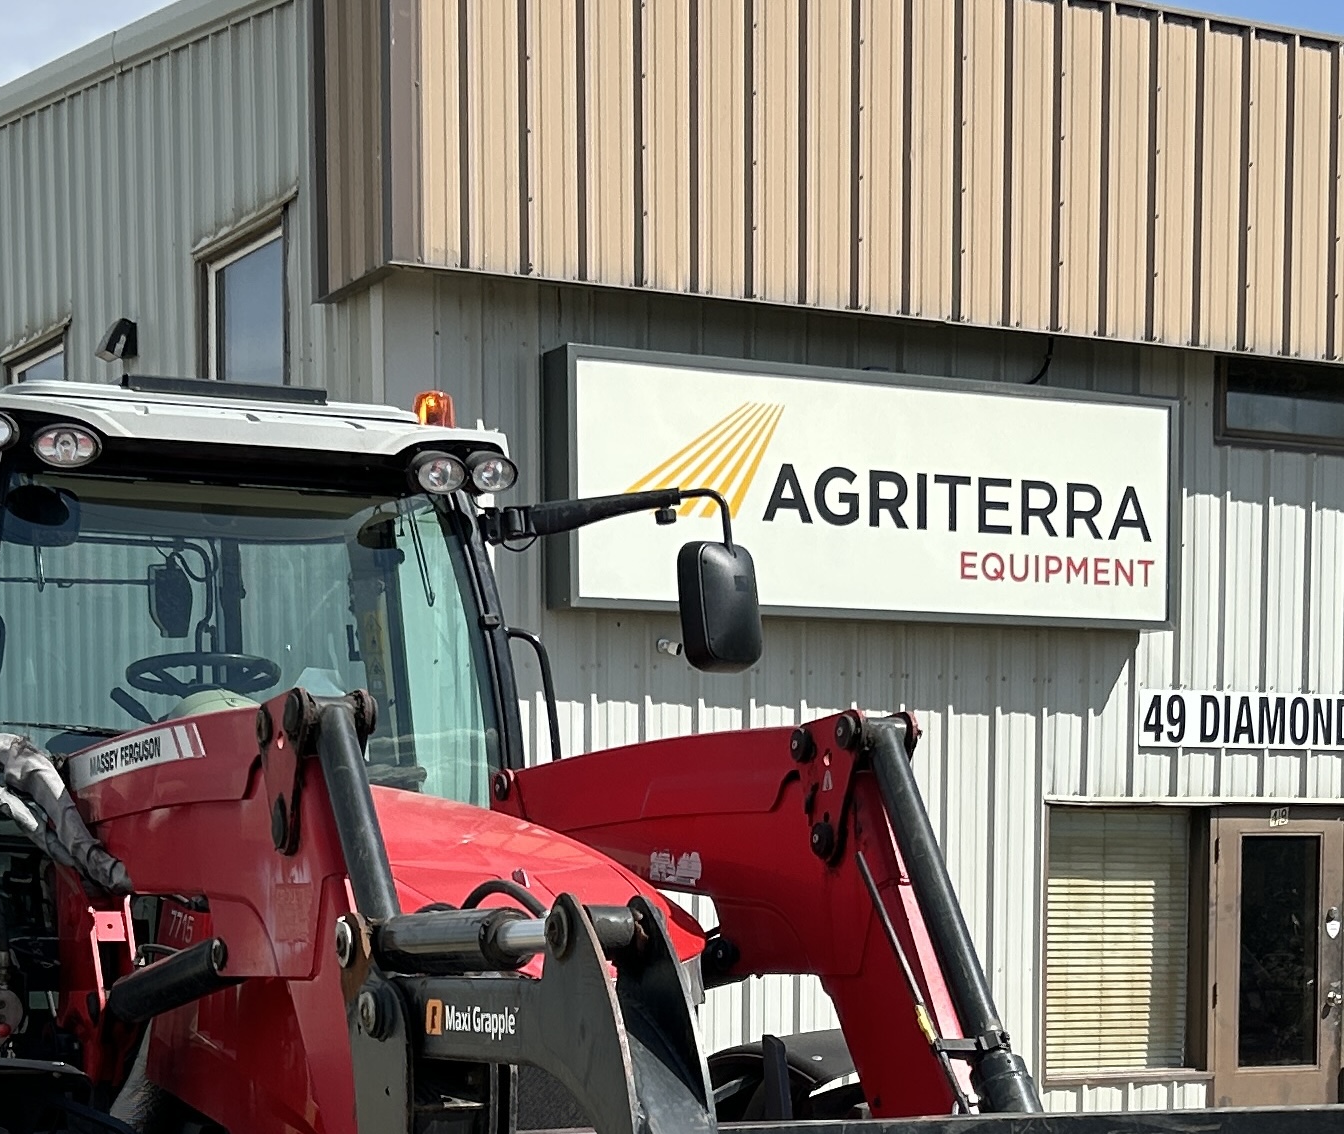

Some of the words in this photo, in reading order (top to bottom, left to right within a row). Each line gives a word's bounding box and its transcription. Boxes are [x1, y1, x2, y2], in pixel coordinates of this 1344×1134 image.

[762, 462, 1153, 543] AGRITERRA
[960, 551, 1155, 588] EQUIPMENT
[1143, 694, 1186, 743] 49
[89, 748, 118, 778] MASSEY
[120, 736, 161, 768] FERGUSON
[445, 1005, 471, 1031] Maxi
[473, 1006, 516, 1040] Grapple
